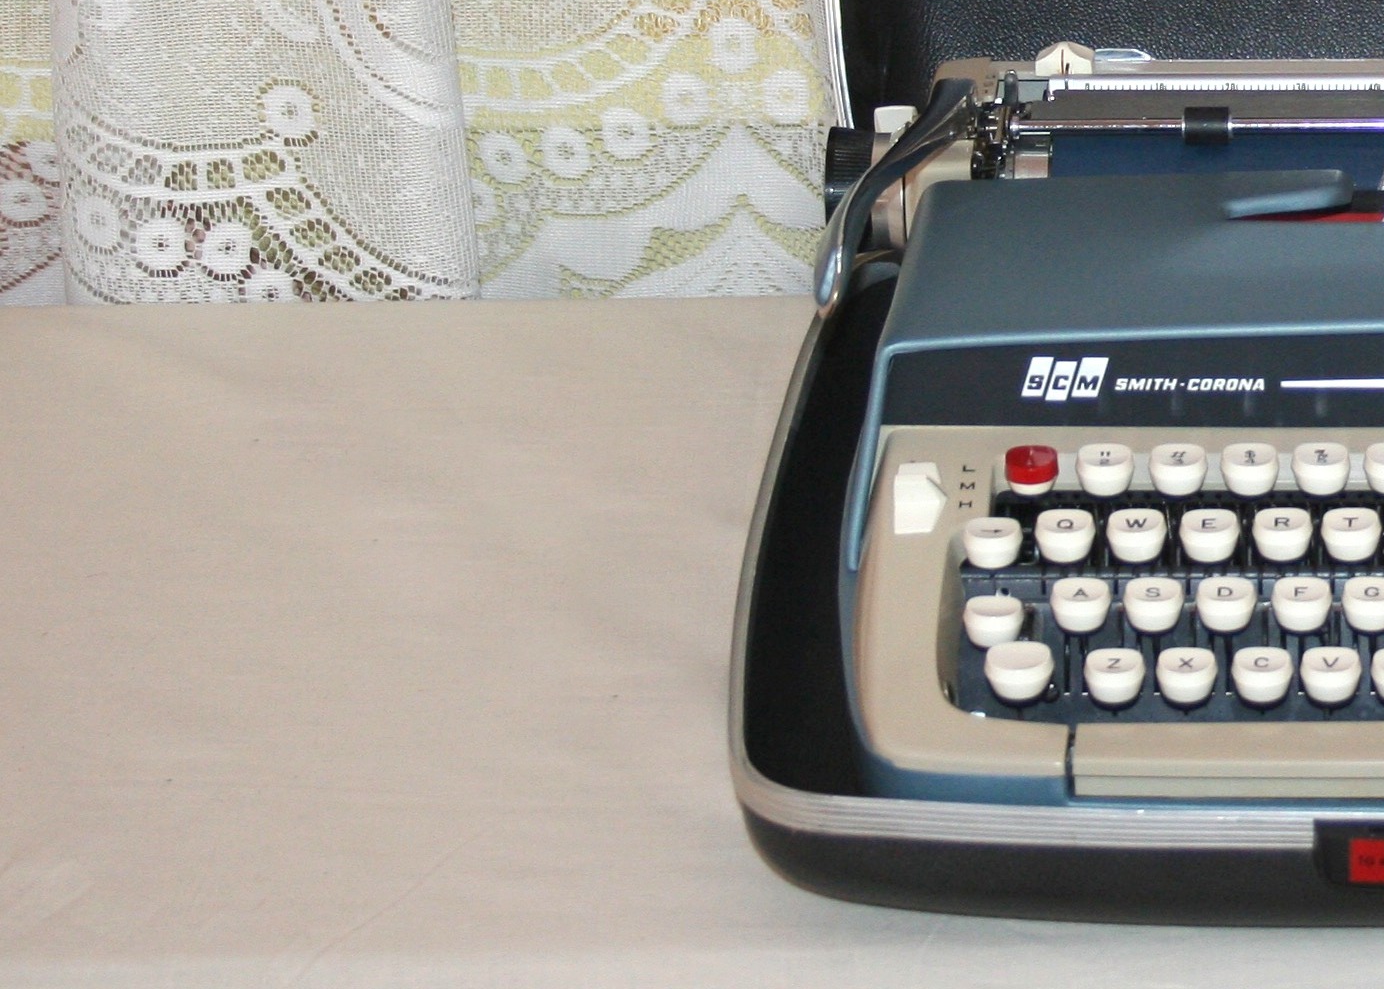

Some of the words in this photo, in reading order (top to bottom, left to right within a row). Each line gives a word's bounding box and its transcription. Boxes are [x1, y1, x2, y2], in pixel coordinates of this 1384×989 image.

[1114, 377, 1266, 392] SMITH-CORONA
[962, 465, 976, 473] L
[960, 482, 976, 490] M
[959, 500, 972, 509] H
[1056, 518, 1074, 530] Q
[1126, 517, 1148, 530] W
[1201, 518, 1216, 530] E
[1273, 517, 1291, 528] R
[1342, 517, 1359, 528] T
[1072, 587, 1089, 598] A
[1145, 587, 1161, 598] S
[1216, 587, 1233, 598] D
[1293, 587, 1308, 598] F
[1363, 587, 1380, 598] G
[1107, 657, 1121, 670] Z
[1179, 657, 1194, 669] X
[1253, 656, 1270, 669] C
[1322, 657, 1339, 668] V
